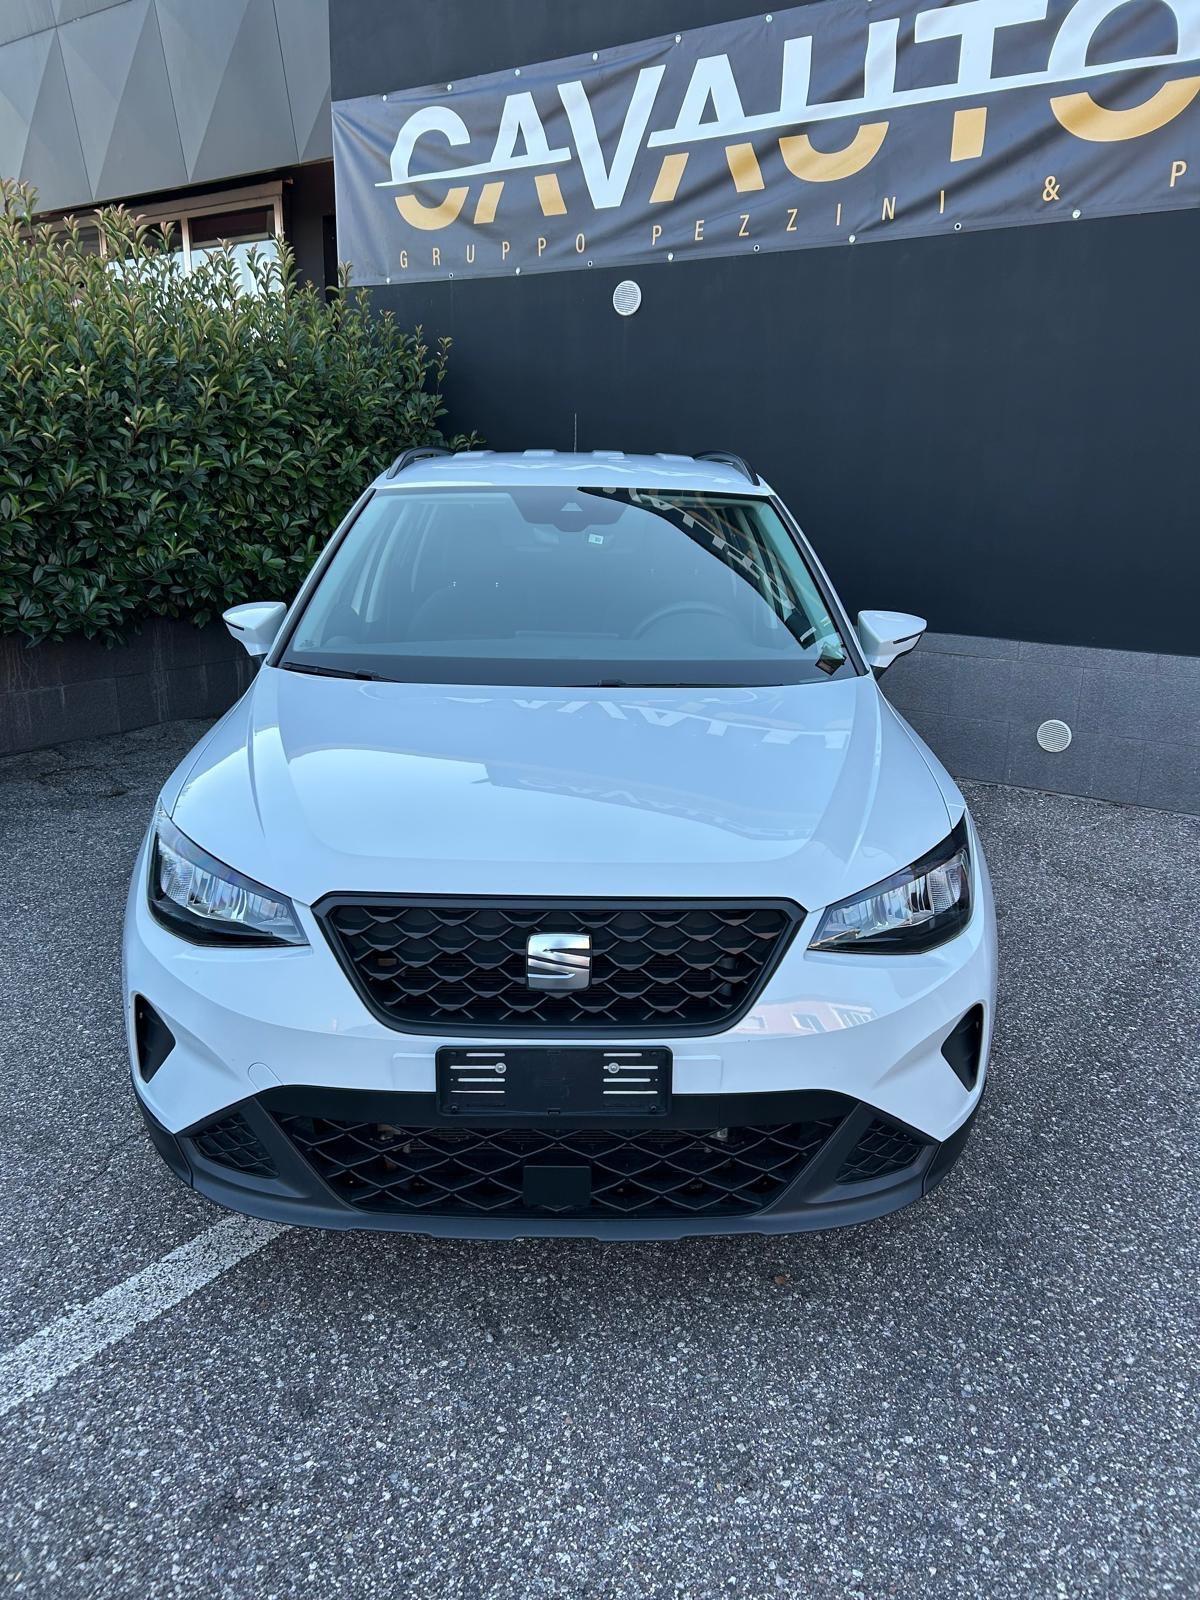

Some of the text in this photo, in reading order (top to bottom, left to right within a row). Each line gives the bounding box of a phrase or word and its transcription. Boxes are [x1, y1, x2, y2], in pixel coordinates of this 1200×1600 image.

[375, 0, 1200, 231] CAVAUTO
[400, 232, 586, 269] GRUPPO
[651, 190, 945, 246] PEZZINI
[1042, 175, 1061, 202] &
